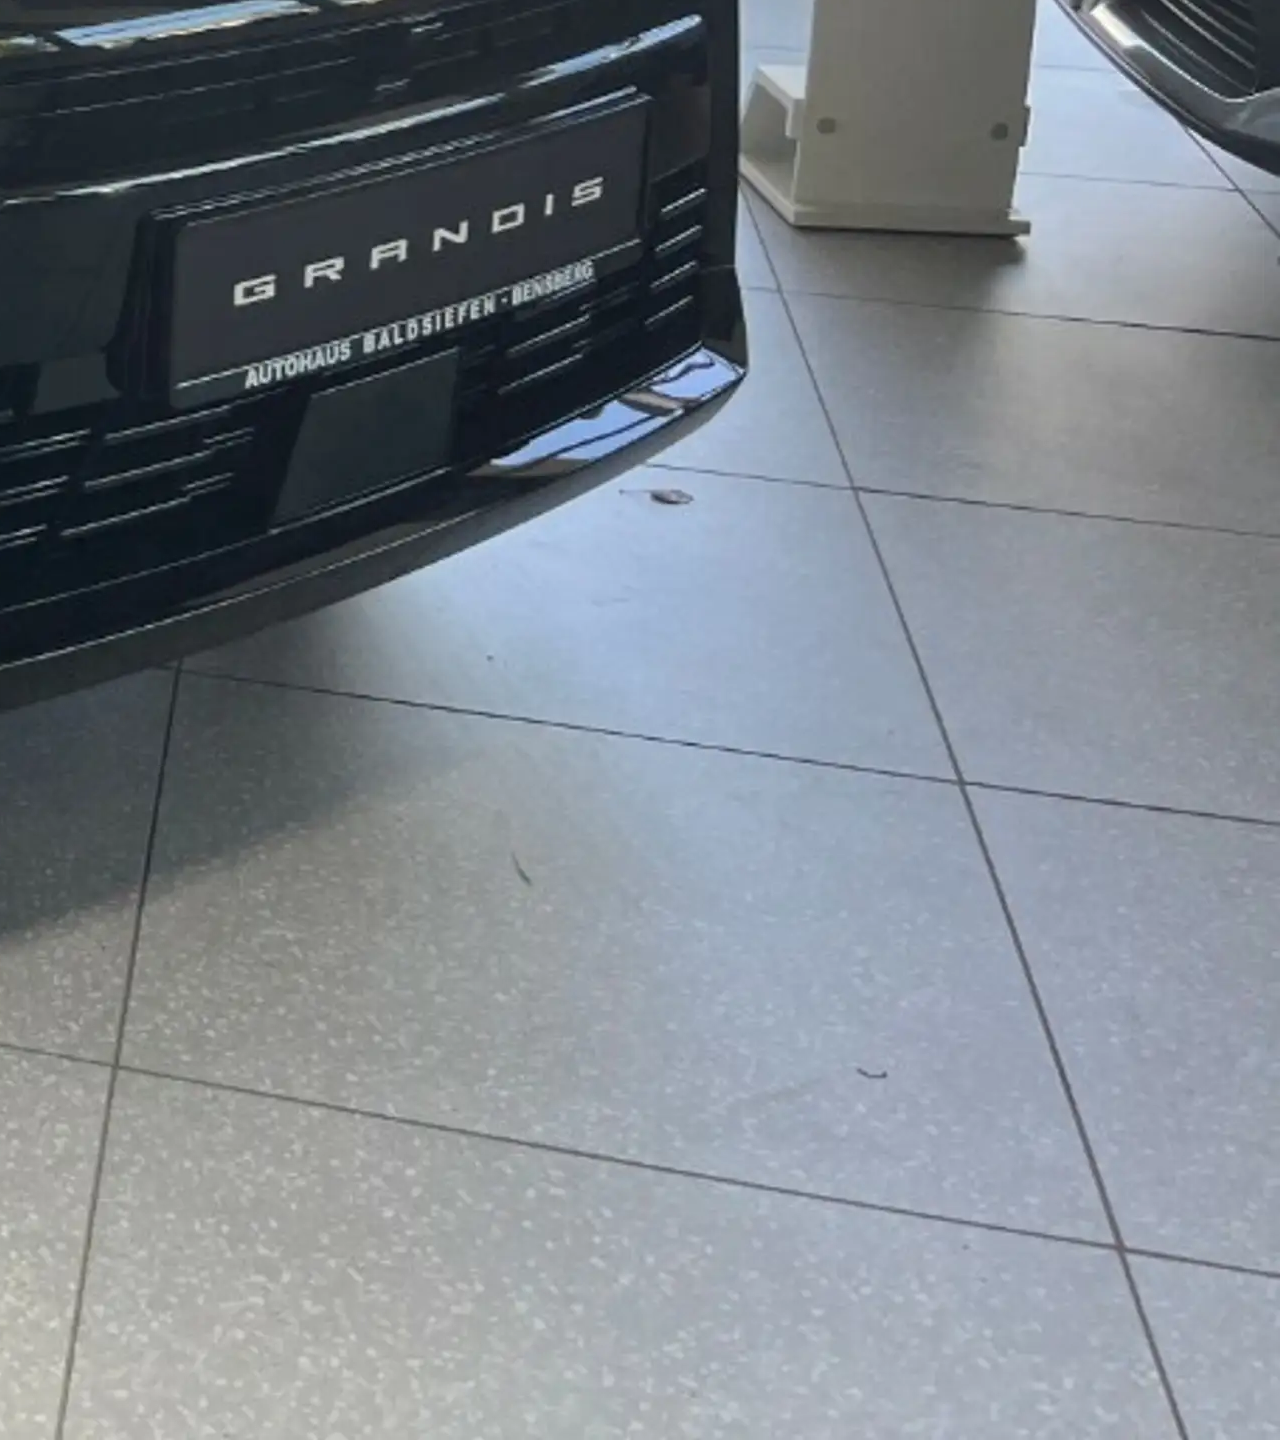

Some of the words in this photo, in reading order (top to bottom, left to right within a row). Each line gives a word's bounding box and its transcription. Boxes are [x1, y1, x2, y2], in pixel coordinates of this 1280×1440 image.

[232, 175, 605, 307] GRANDIS
[244, 340, 352, 389] AUTOHAUS
[362, 292, 496, 354] BALDSIEFEN
[511, 260, 596, 307] BENSBERG
